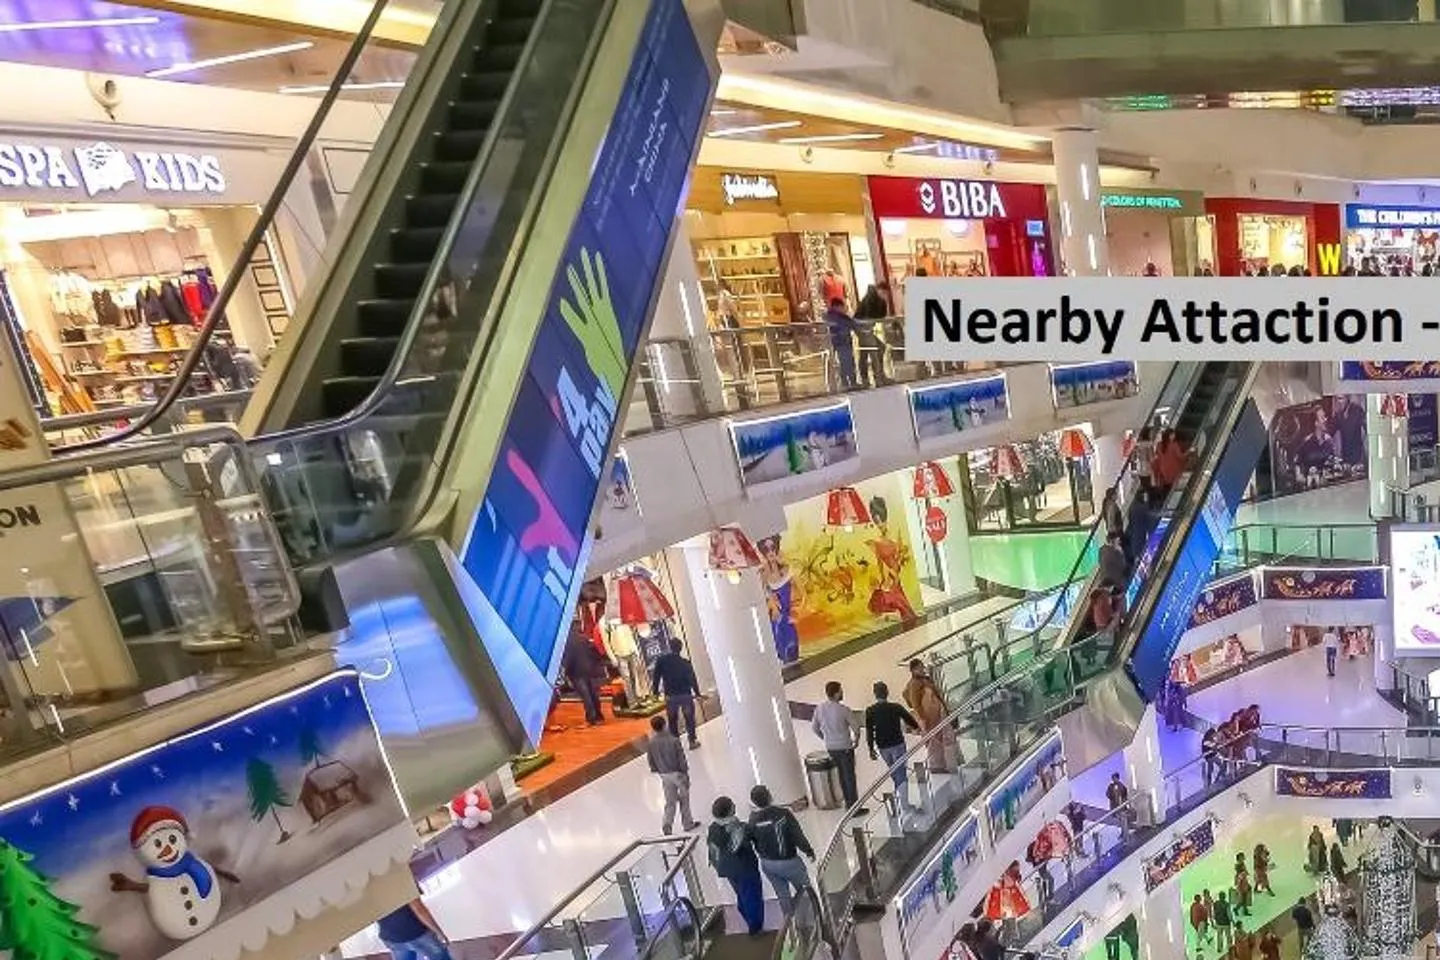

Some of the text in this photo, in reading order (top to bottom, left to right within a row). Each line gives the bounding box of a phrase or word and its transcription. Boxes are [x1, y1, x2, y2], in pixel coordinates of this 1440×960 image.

[133, 152, 226, 193] KIDS
[940, 180, 1006, 218] BIBA
[1357, 209, 1377, 224] THE
